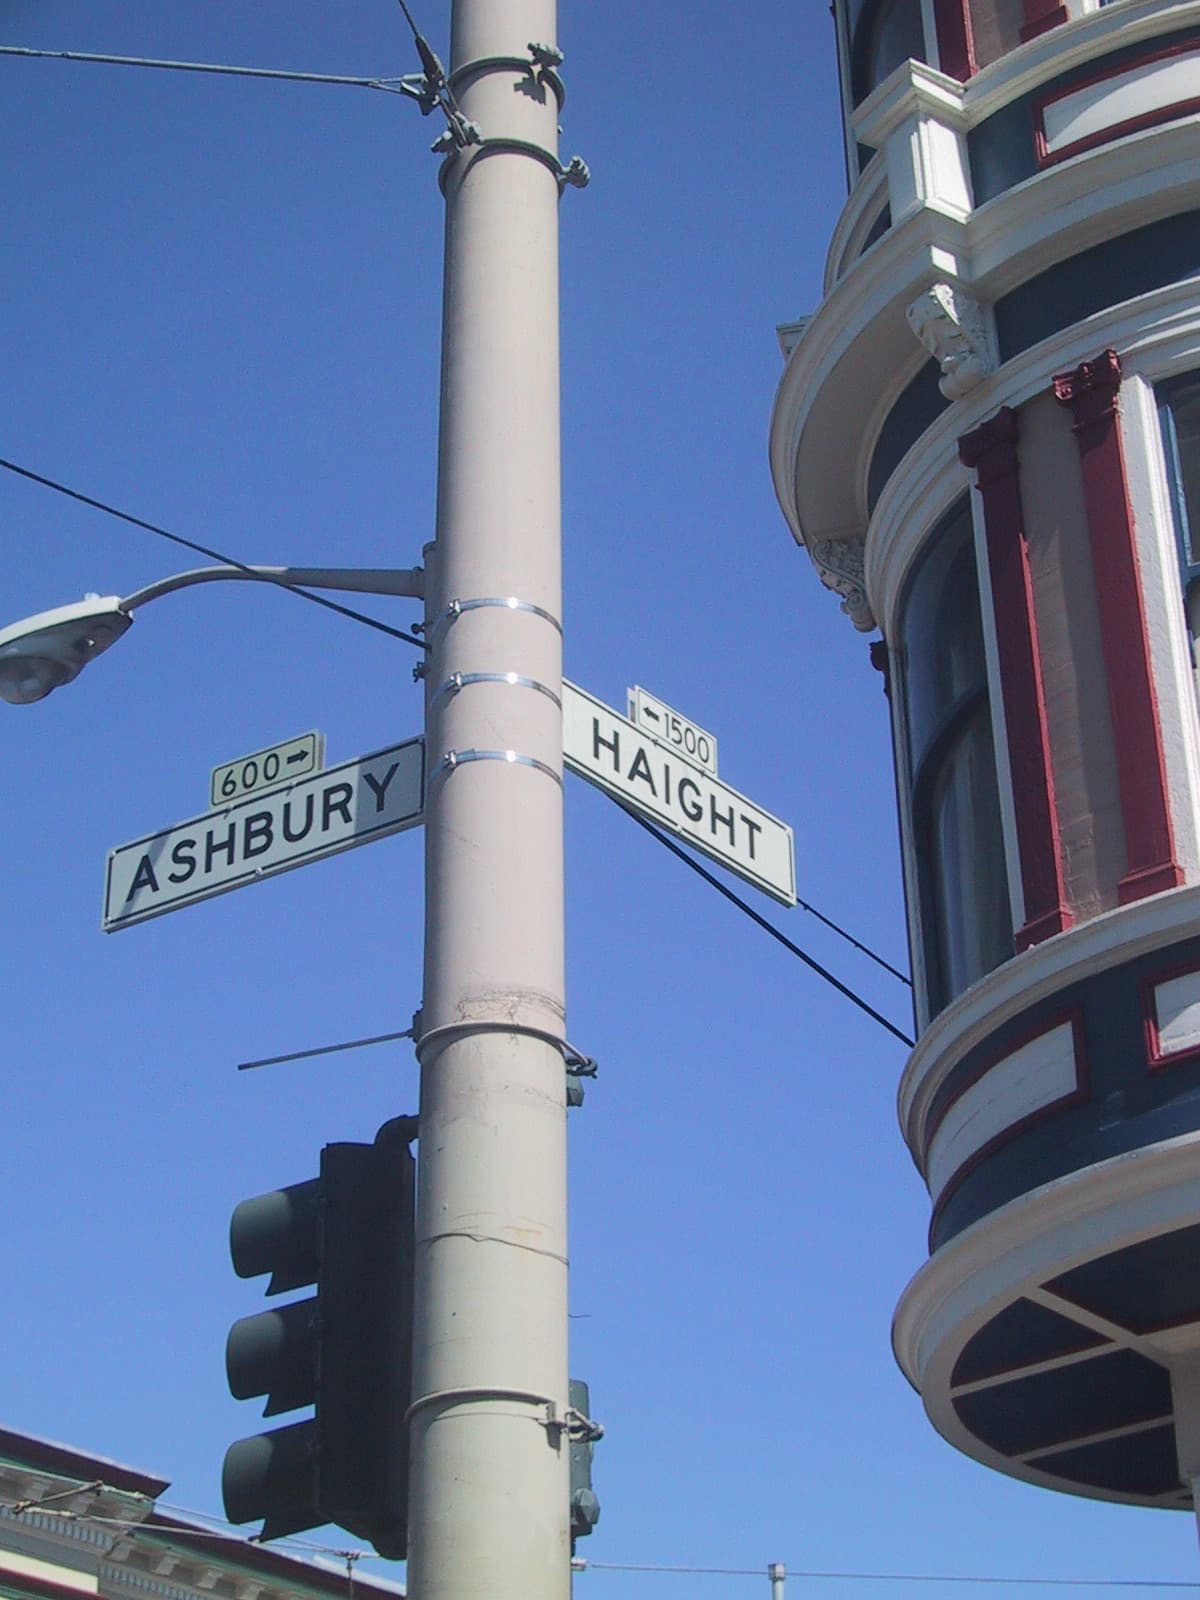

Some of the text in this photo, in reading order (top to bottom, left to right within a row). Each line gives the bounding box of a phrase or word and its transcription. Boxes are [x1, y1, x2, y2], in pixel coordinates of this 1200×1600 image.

[221, 752, 280, 797] 600
[664, 712, 710, 764] 1500
[125, 762, 400, 903] ASHBURY
[592, 716, 762, 861] HAIGHT
